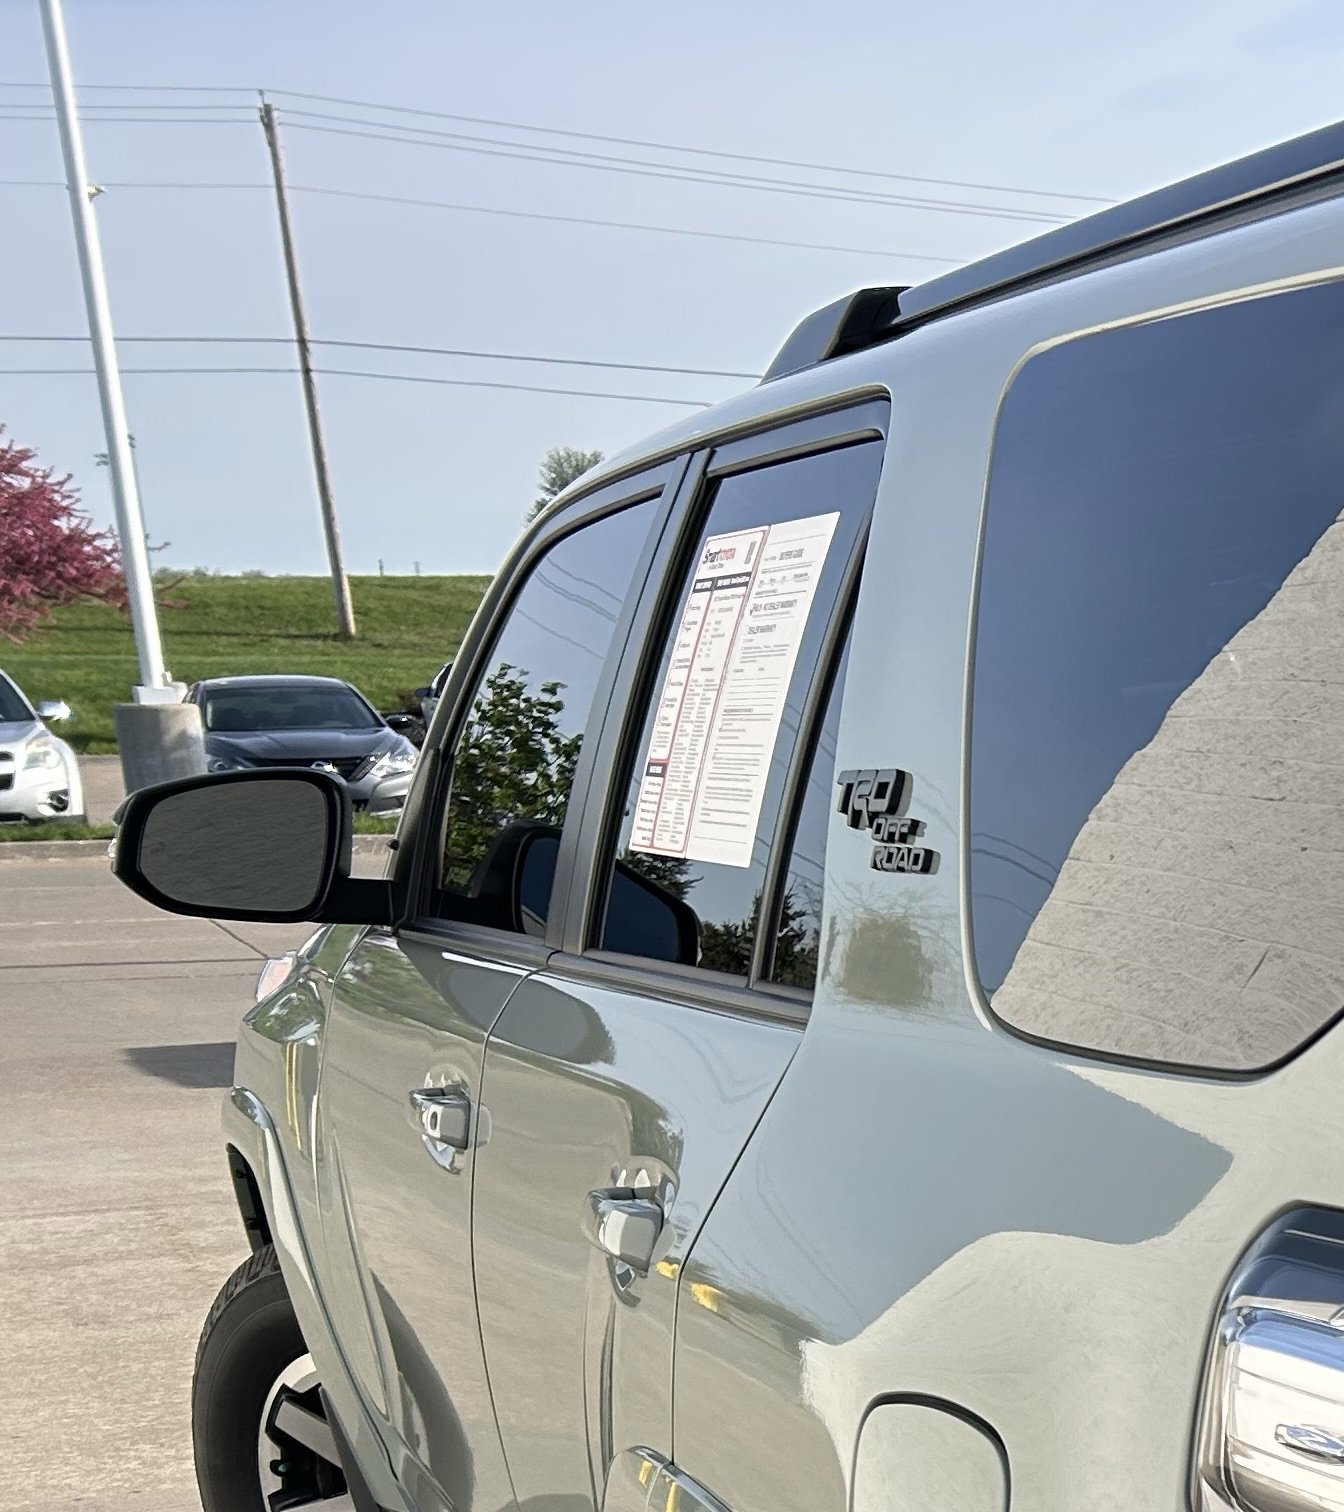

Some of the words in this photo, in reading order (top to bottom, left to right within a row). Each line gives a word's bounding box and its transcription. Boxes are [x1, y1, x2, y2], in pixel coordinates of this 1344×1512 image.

[837, 769, 912, 830] TRD
[871, 817, 927, 845] OFF
[870, 845, 941, 875] ROAD
